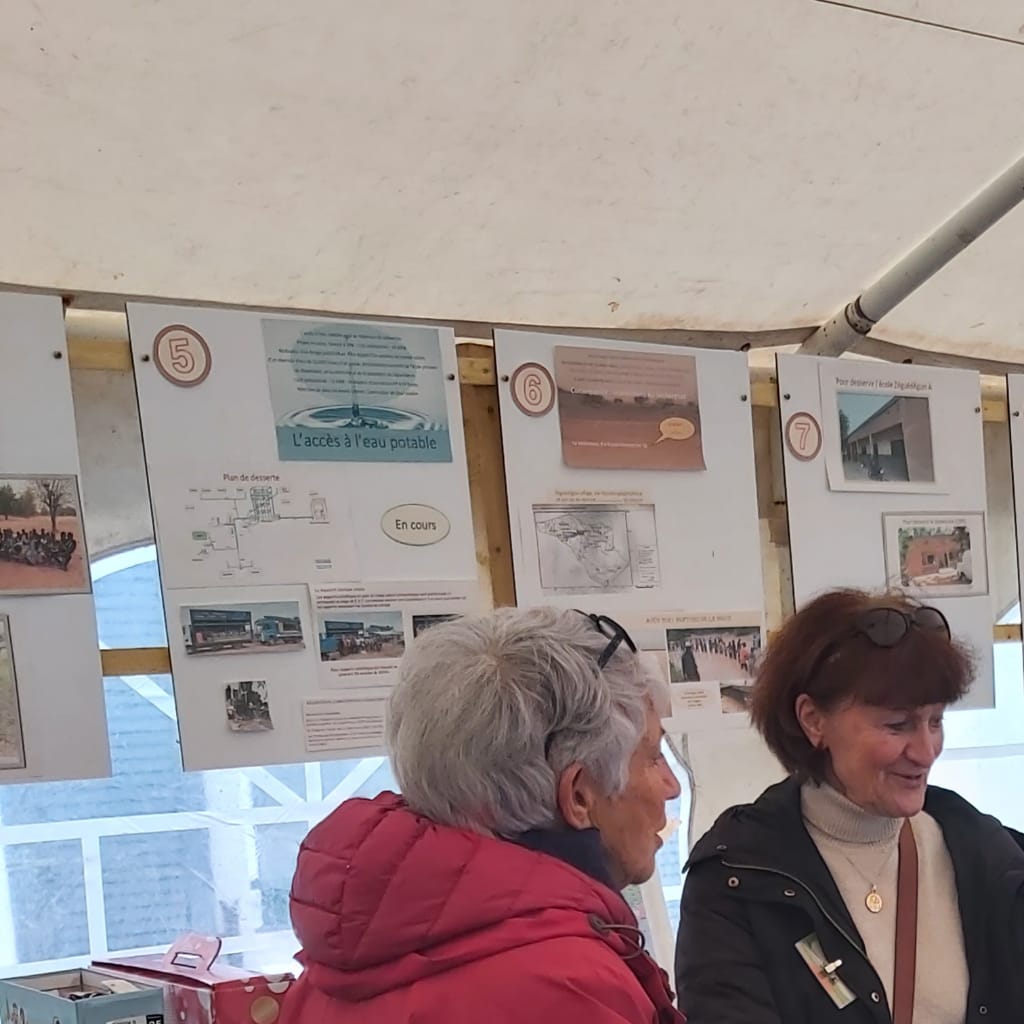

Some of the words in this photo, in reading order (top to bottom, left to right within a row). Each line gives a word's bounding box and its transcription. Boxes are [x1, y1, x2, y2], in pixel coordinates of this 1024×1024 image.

[169, 338, 195, 374] 5
[524, 374, 542, 405] 6
[292, 433, 341, 448] L'accès
[344, 433, 351, 448] à
[355, 433, 386, 449] l'eau
[391, 435, 437, 451] potable
[795, 423, 811, 450] 7
[223, 473, 239, 481] Plan
[240, 473, 249, 481] de
[250, 473, 280, 482] desserte
[395, 519, 408, 530] En
[410, 520, 437, 531] cours
